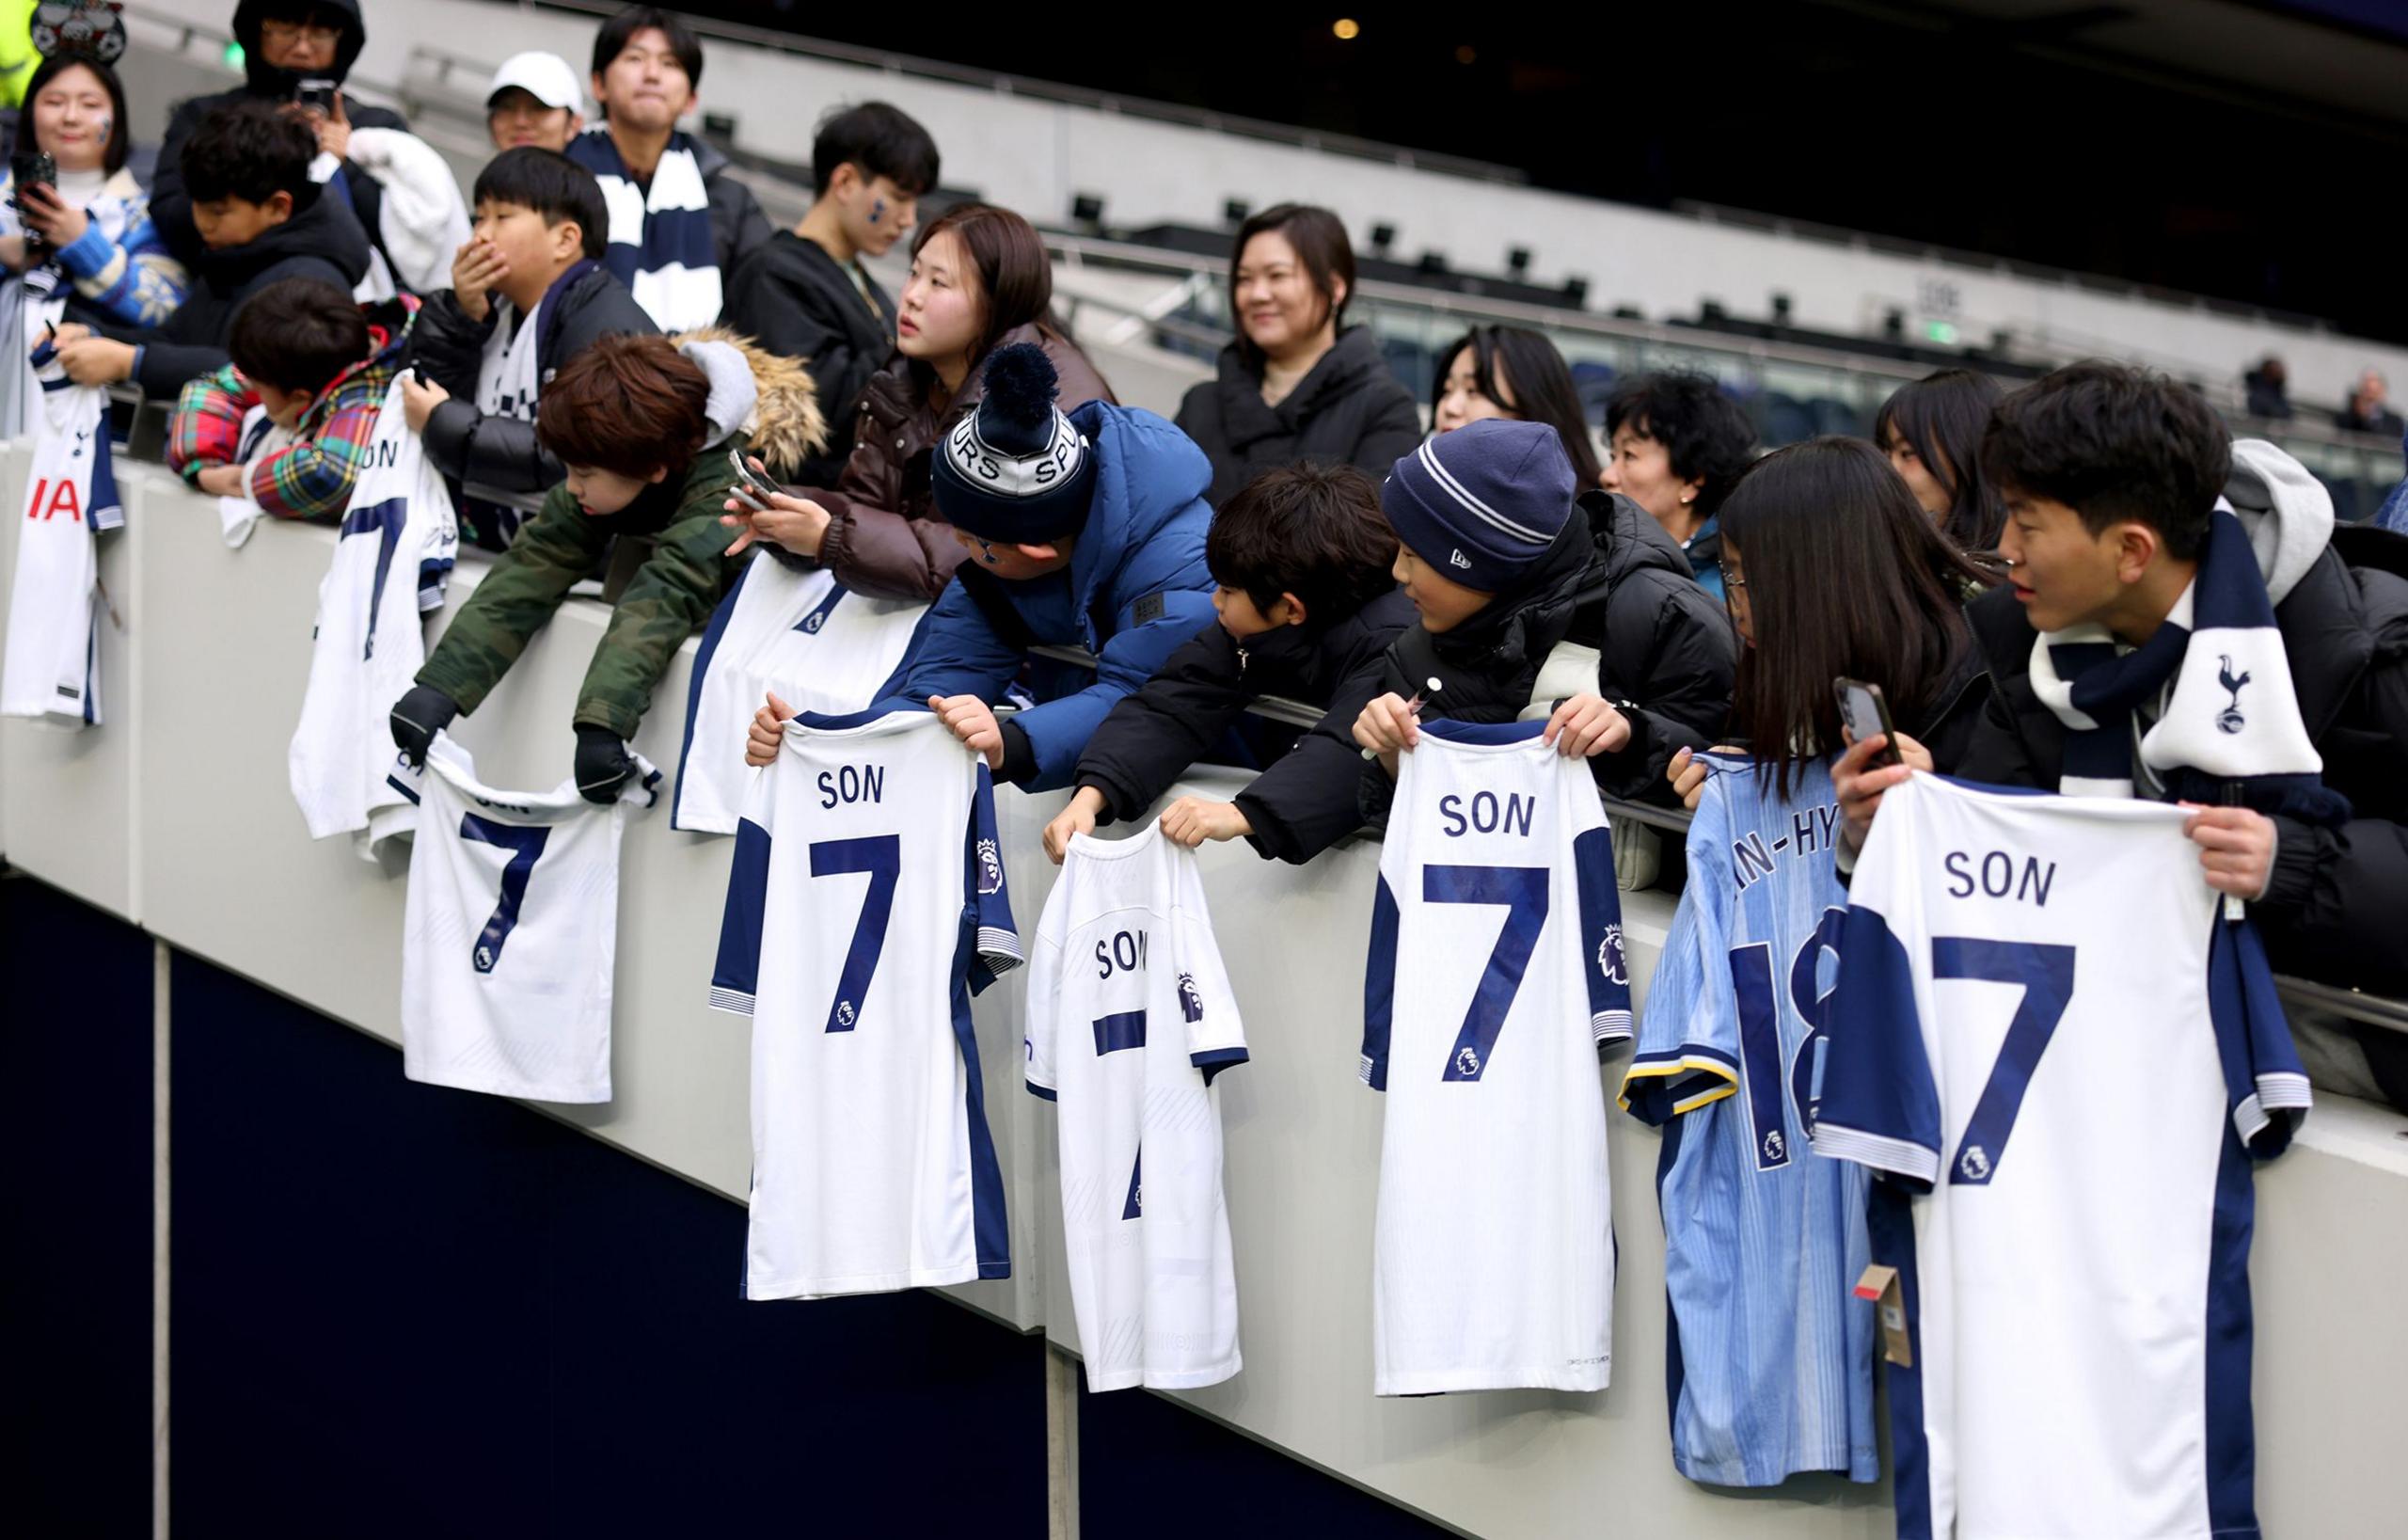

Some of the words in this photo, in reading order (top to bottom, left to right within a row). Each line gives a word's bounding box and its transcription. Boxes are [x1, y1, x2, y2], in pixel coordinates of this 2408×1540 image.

[954, 415, 1001, 480] URS
[341, 498, 407, 661] 7
[817, 764, 884, 809] SON
[1438, 790, 1535, 837] SON
[460, 811, 553, 974] 7
[1732, 802, 1840, 894] N-HY
[1944, 850, 2056, 907] SON
[809, 834, 900, 1034] 7
[1096, 929, 1148, 979] SON
[1423, 864, 1550, 1082] 7
[1931, 936, 2077, 1185] 7
